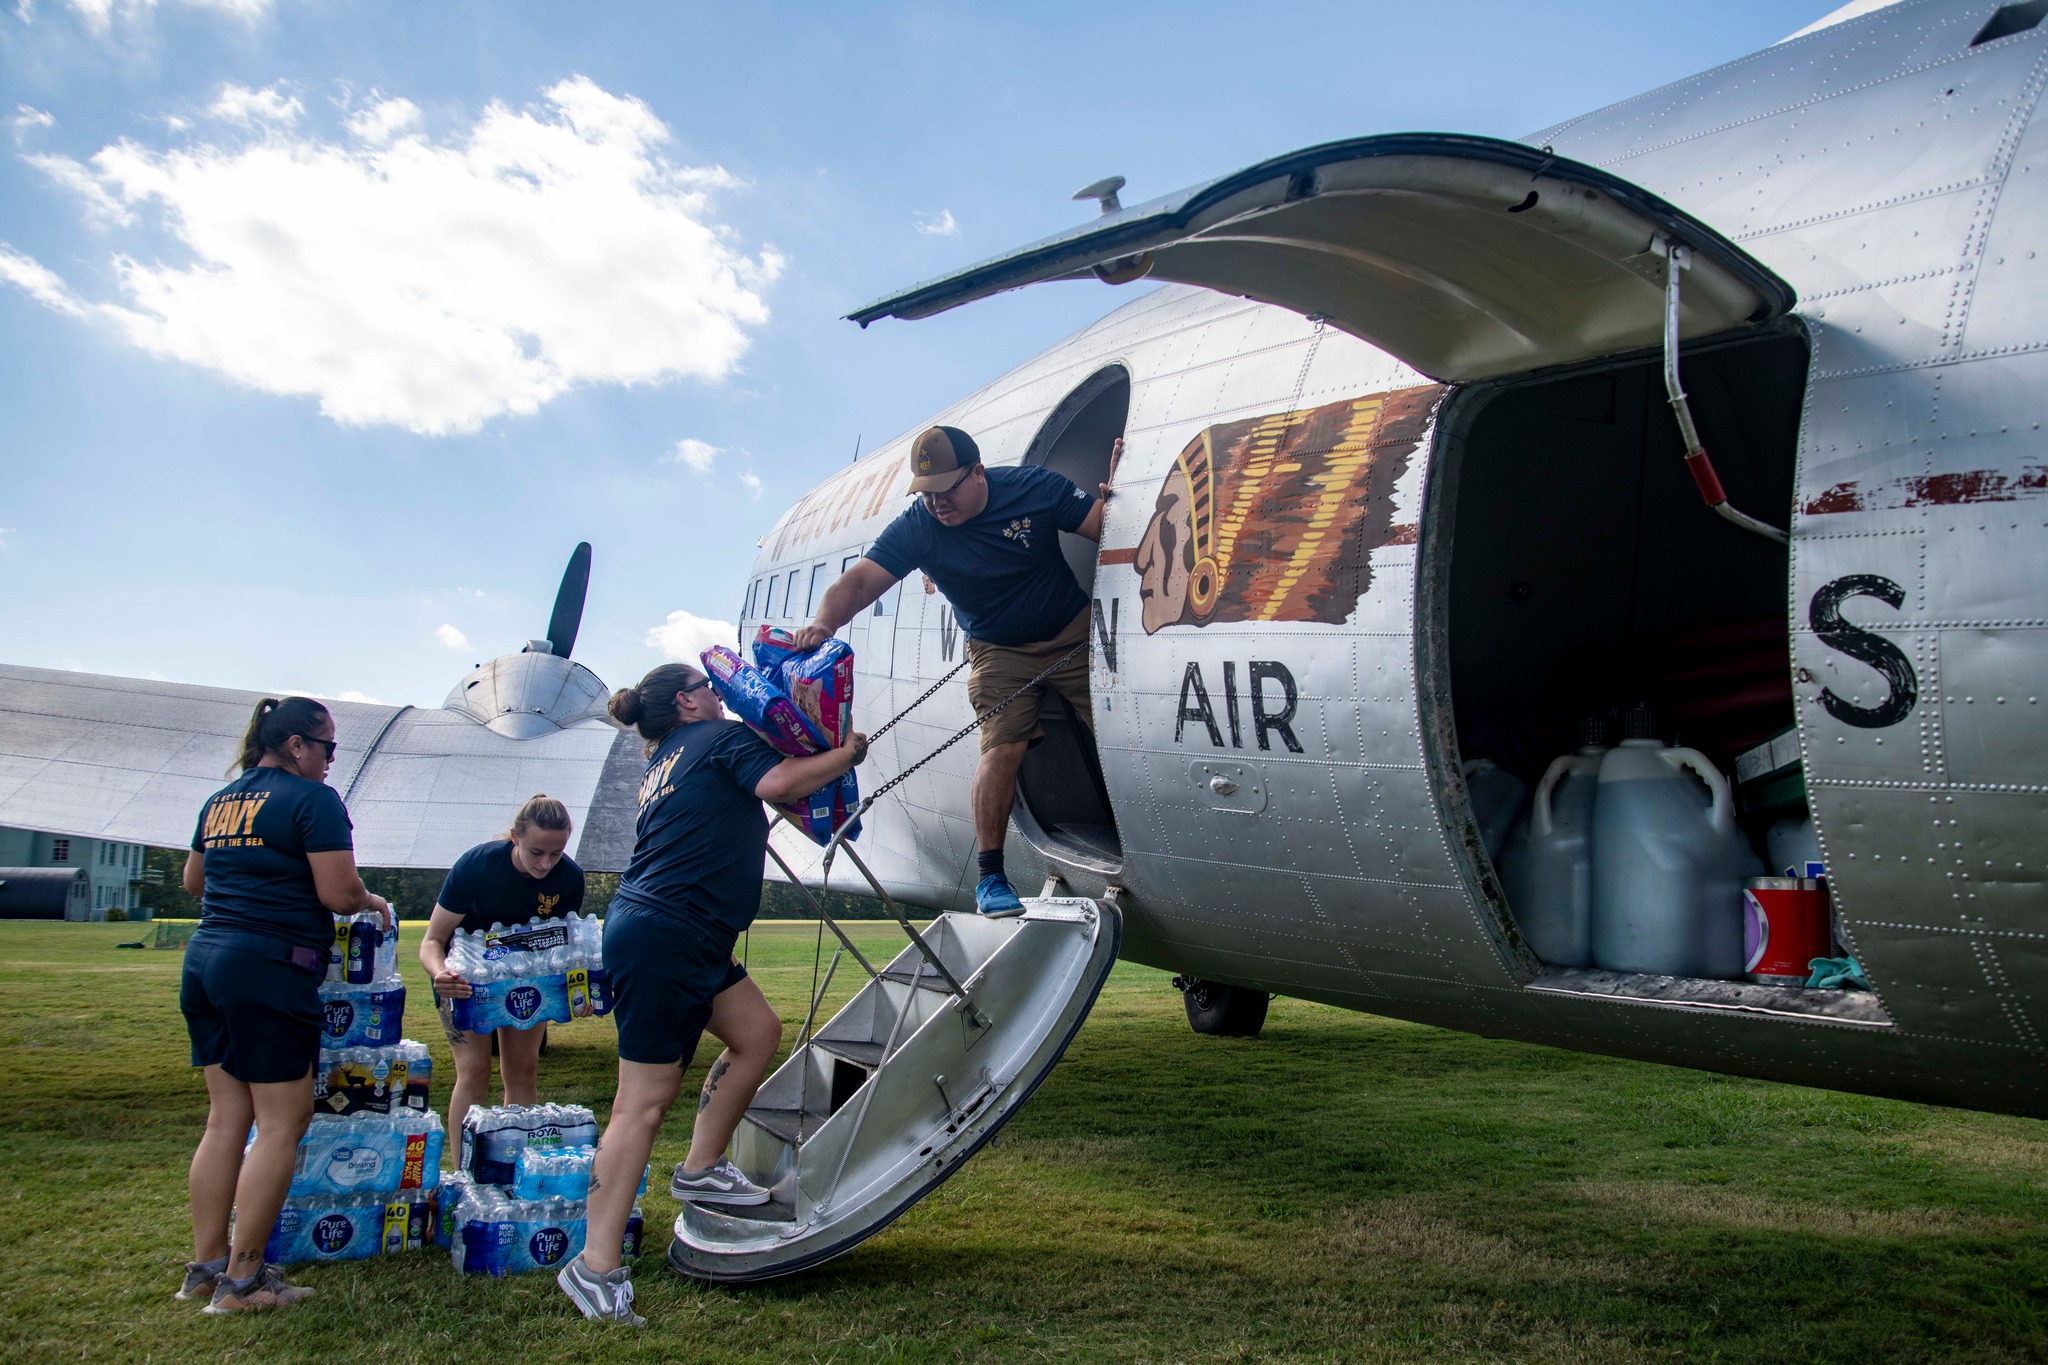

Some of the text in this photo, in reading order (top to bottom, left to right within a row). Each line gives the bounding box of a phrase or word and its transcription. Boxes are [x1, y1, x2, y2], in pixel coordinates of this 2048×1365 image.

[1174, 660, 1305, 754] AIR
[203, 799, 267, 840] NAVY
[228, 838, 242, 847] THE
[245, 837, 264, 847] SEA
[568, 972, 585, 984] 40
[510, 989, 535, 1000] Pure
[323, 1004, 351, 1015] Pure
[513, 998, 534, 1010] Life
[326, 1013, 348, 1027] Life
[392, 1064, 407, 1072] 40
[527, 1127, 563, 1139] ROYAL
[407, 1140, 425, 1151] 40
[527, 1136, 563, 1147] FARMS
[348, 1161, 376, 1169] Drinking
[386, 1206, 407, 1218] 40
[319, 1219, 347, 1230] Pure
[321, 1228, 344, 1242] Life
[536, 1232, 563, 1243] Pure
[538, 1241, 561, 1254] Life
